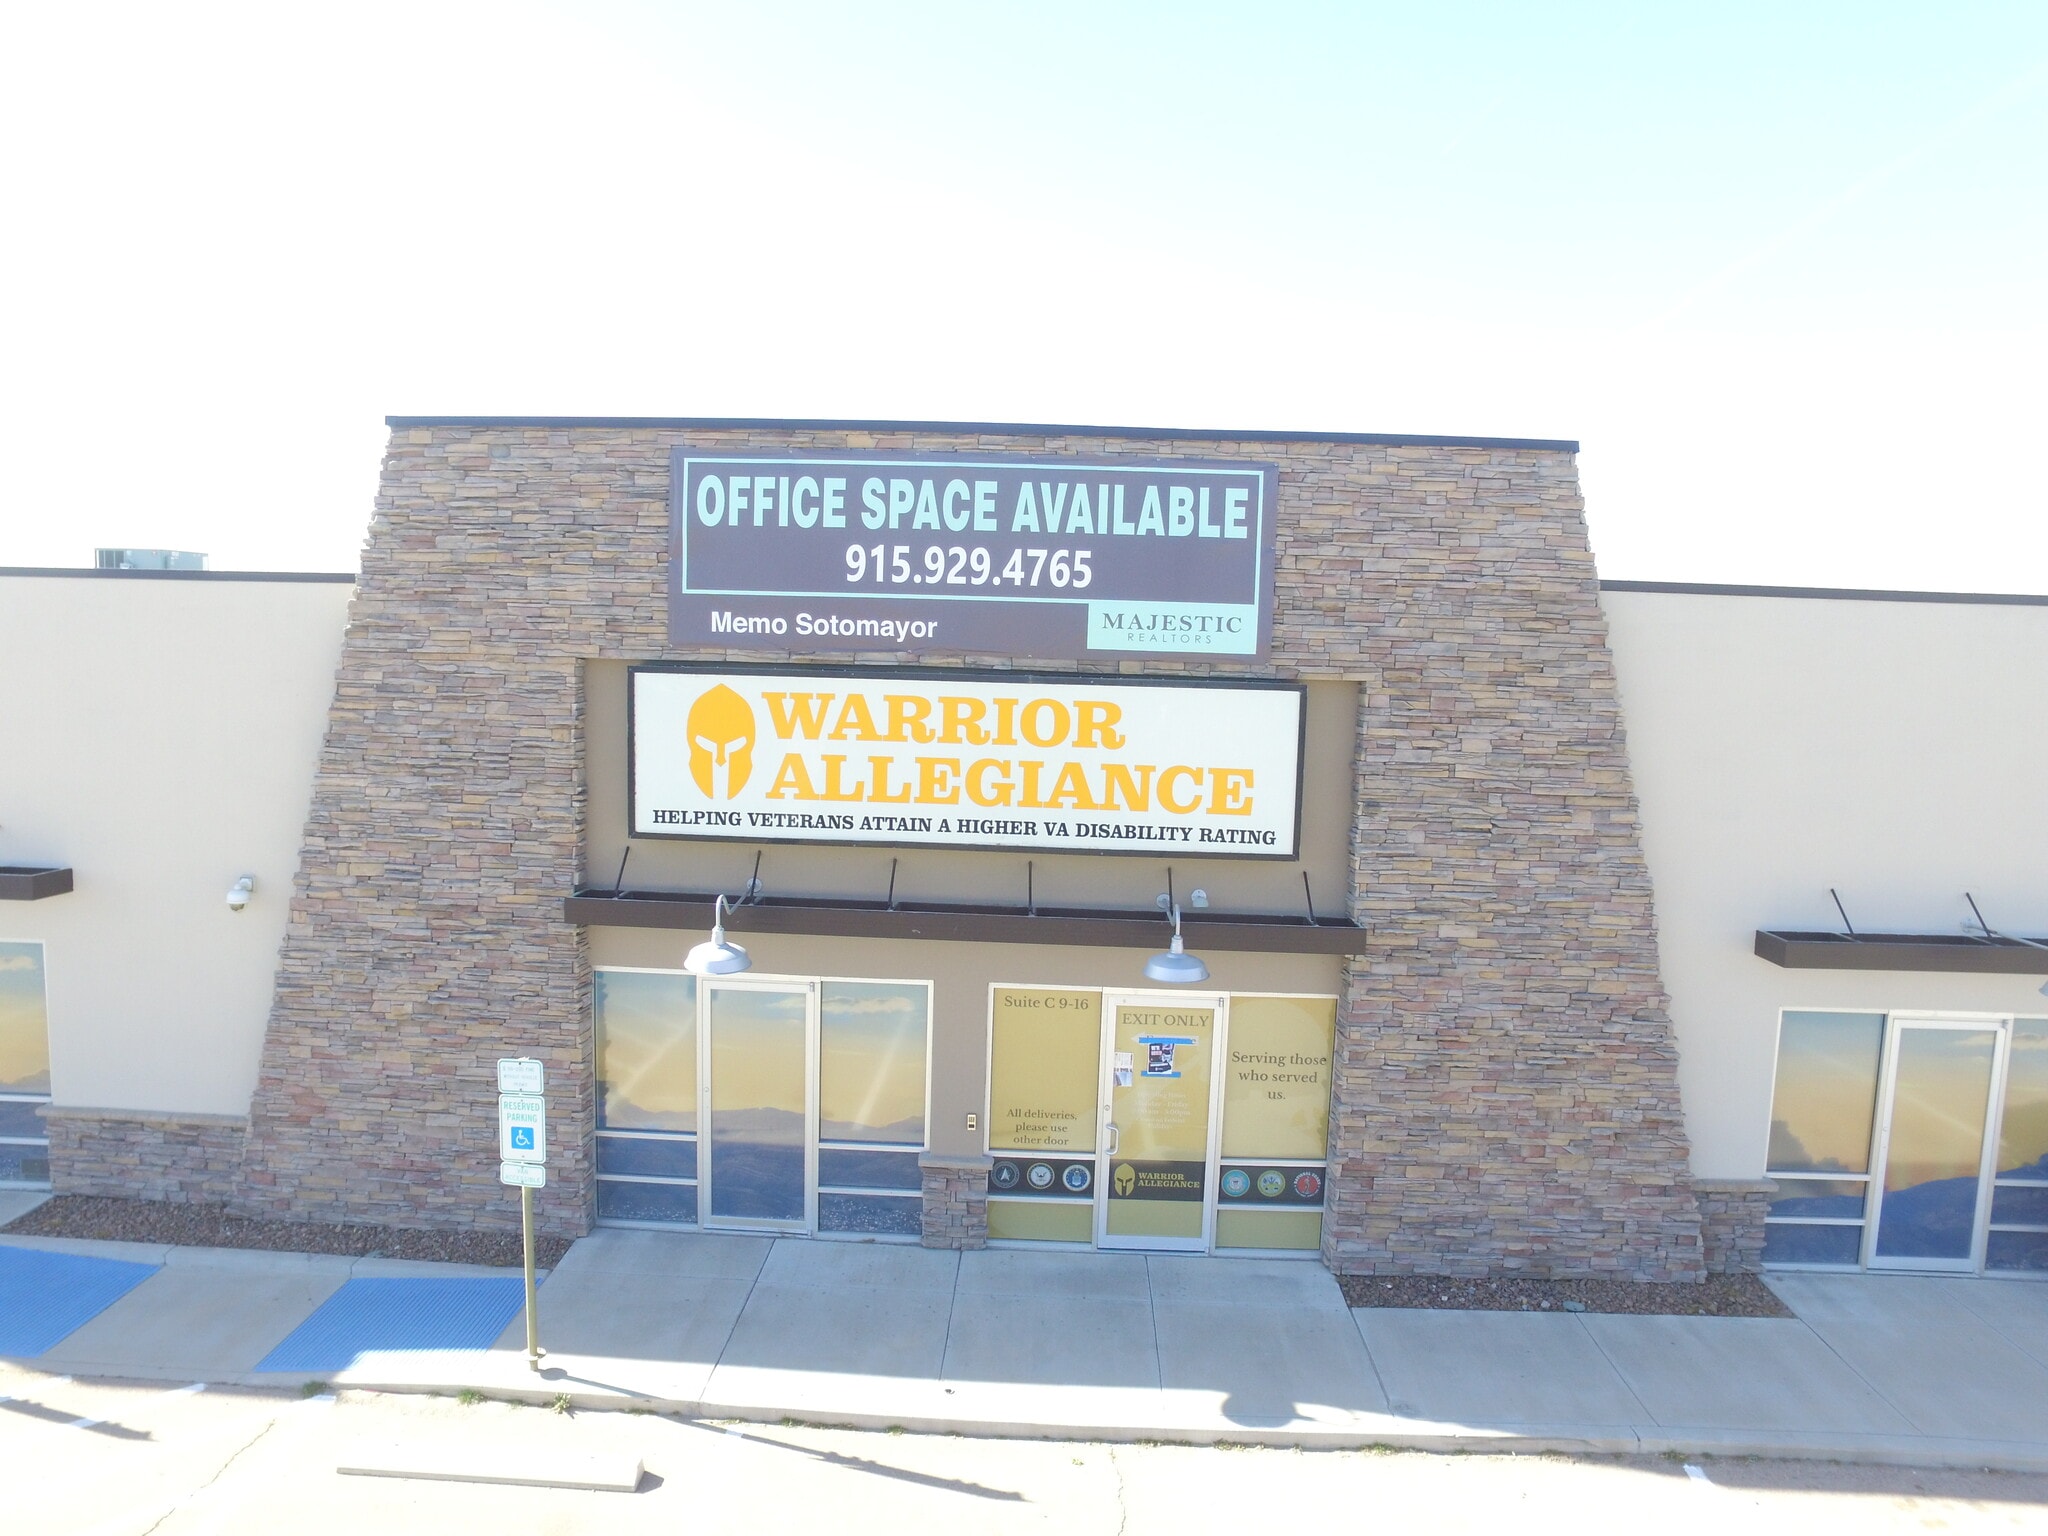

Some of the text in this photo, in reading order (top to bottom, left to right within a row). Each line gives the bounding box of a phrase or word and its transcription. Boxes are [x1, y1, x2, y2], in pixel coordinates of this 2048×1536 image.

[697, 474, 1249, 539] OFFICE SPACE AVAILABLE
[845, 544, 1092, 588] 915.929.4765
[711, 611, 938, 642] Memo Sotomayor
[1102, 612, 1242, 633] MAJESTIC
[1127, 632, 1212, 644] REALTORS
[761, 691, 1126, 750] WARRIOR
[765, 753, 1254, 816] ALLEGIANCE
[652, 809, 1277, 846] HELPING VETERANS ATTAIN A HIGHER VA DISABILITY RATING
[1004, 995, 1089, 1010] Suite C 9-16
[1122, 1013, 1210, 1027] EXIT ONLY
[1231, 1051, 1327, 1067] Serving those
[1239, 1069, 1318, 1083] who served
[1268, 1091, 1286, 1100] us.
[503, 1101, 540, 1112] RESERVED
[1006, 1108, 1022, 1118] All
[506, 1112, 538, 1123] PARKING
[1015, 1122, 1068, 1133] please use
[1013, 1135, 1069, 1146] other door
[1138, 1172, 1185, 1181] WARRIOR
[1137, 1179, 1200, 1189] ALLEGIANCE
